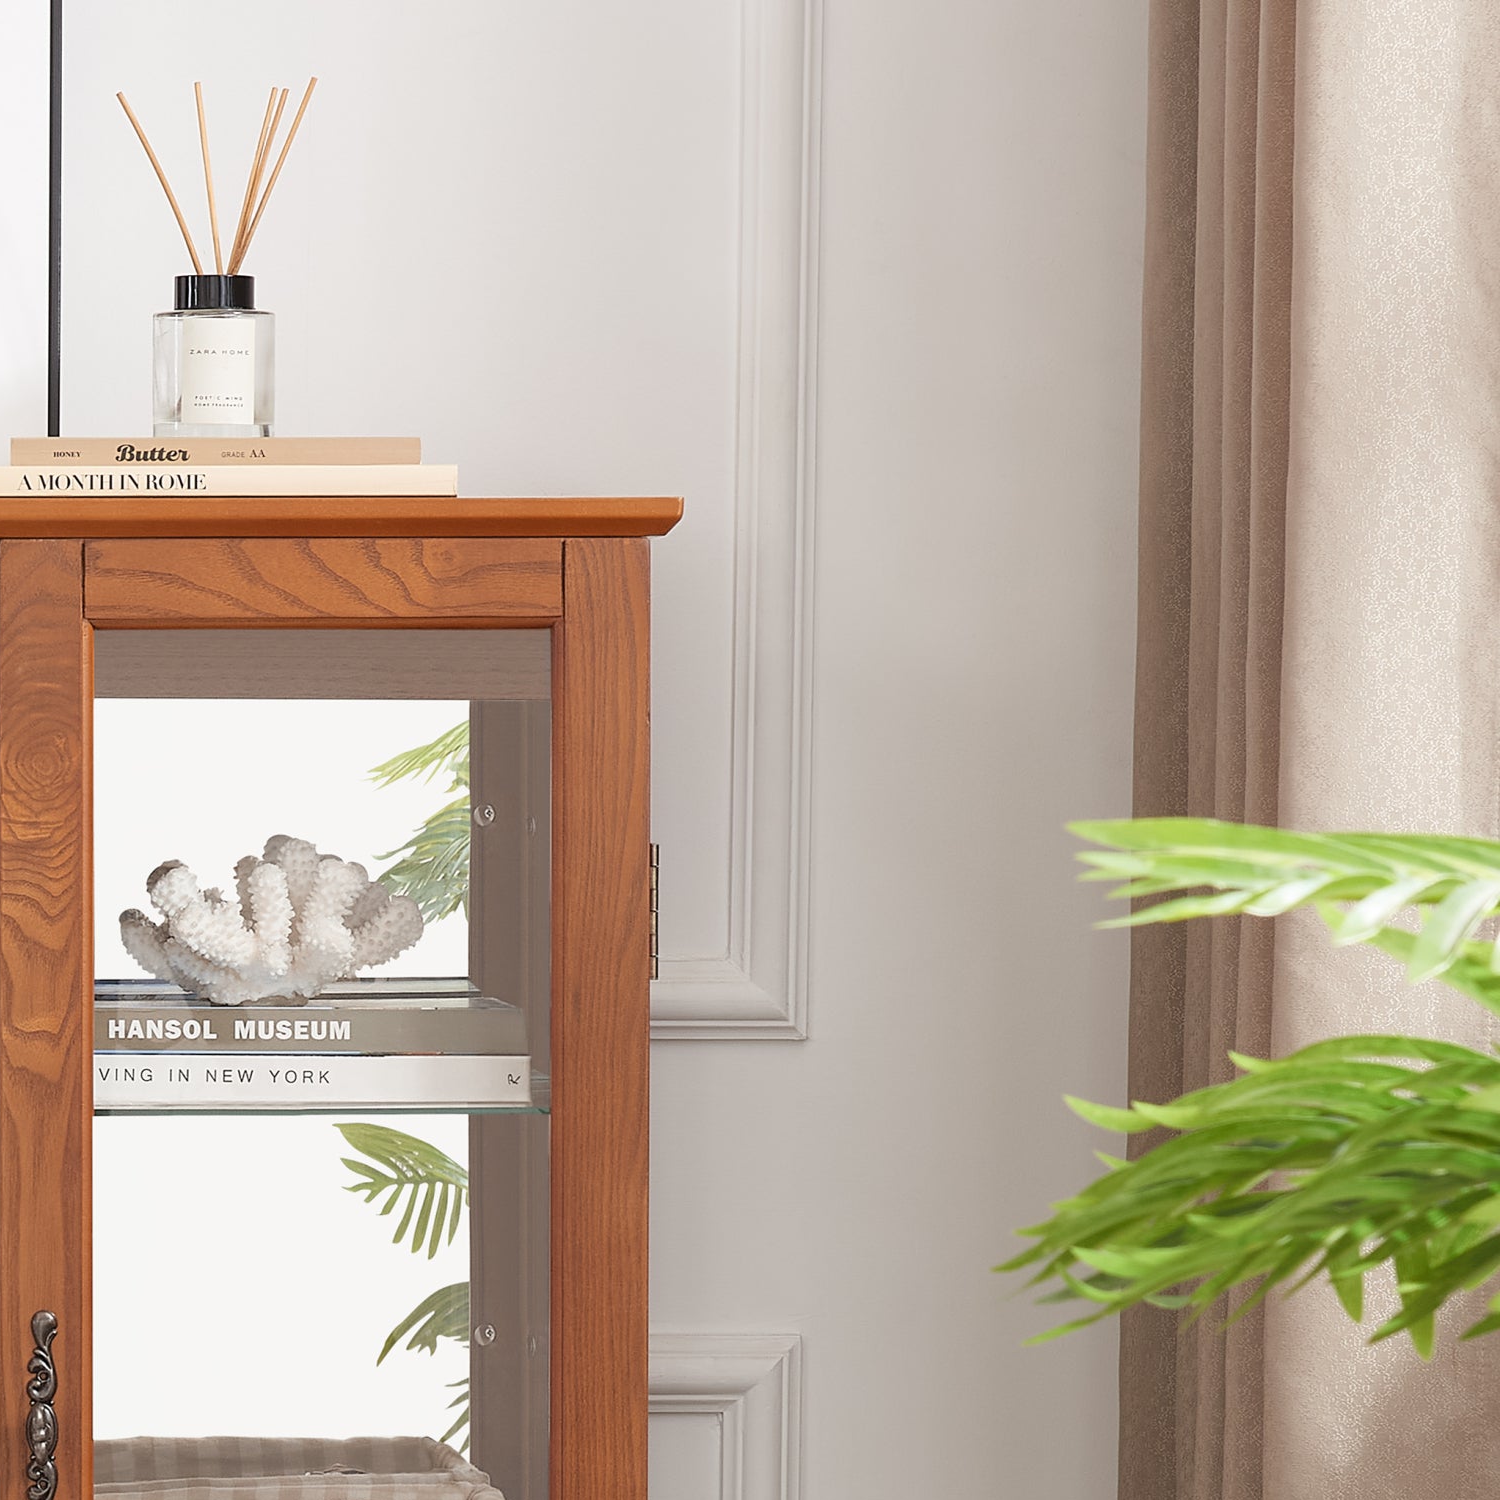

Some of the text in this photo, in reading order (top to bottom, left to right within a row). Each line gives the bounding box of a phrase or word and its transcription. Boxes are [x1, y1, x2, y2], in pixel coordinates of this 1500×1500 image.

[115, 443, 191, 462] Butter
[249, 449, 266, 458] AA
[17, 474, 207, 491] A MONTH IN ROME
[108, 1019, 351, 1041] HANSOL MUSEUM
[168, 1068, 190, 1082] IN
[205, 1068, 254, 1083] NEW
[268, 1069, 331, 1084] YORK
